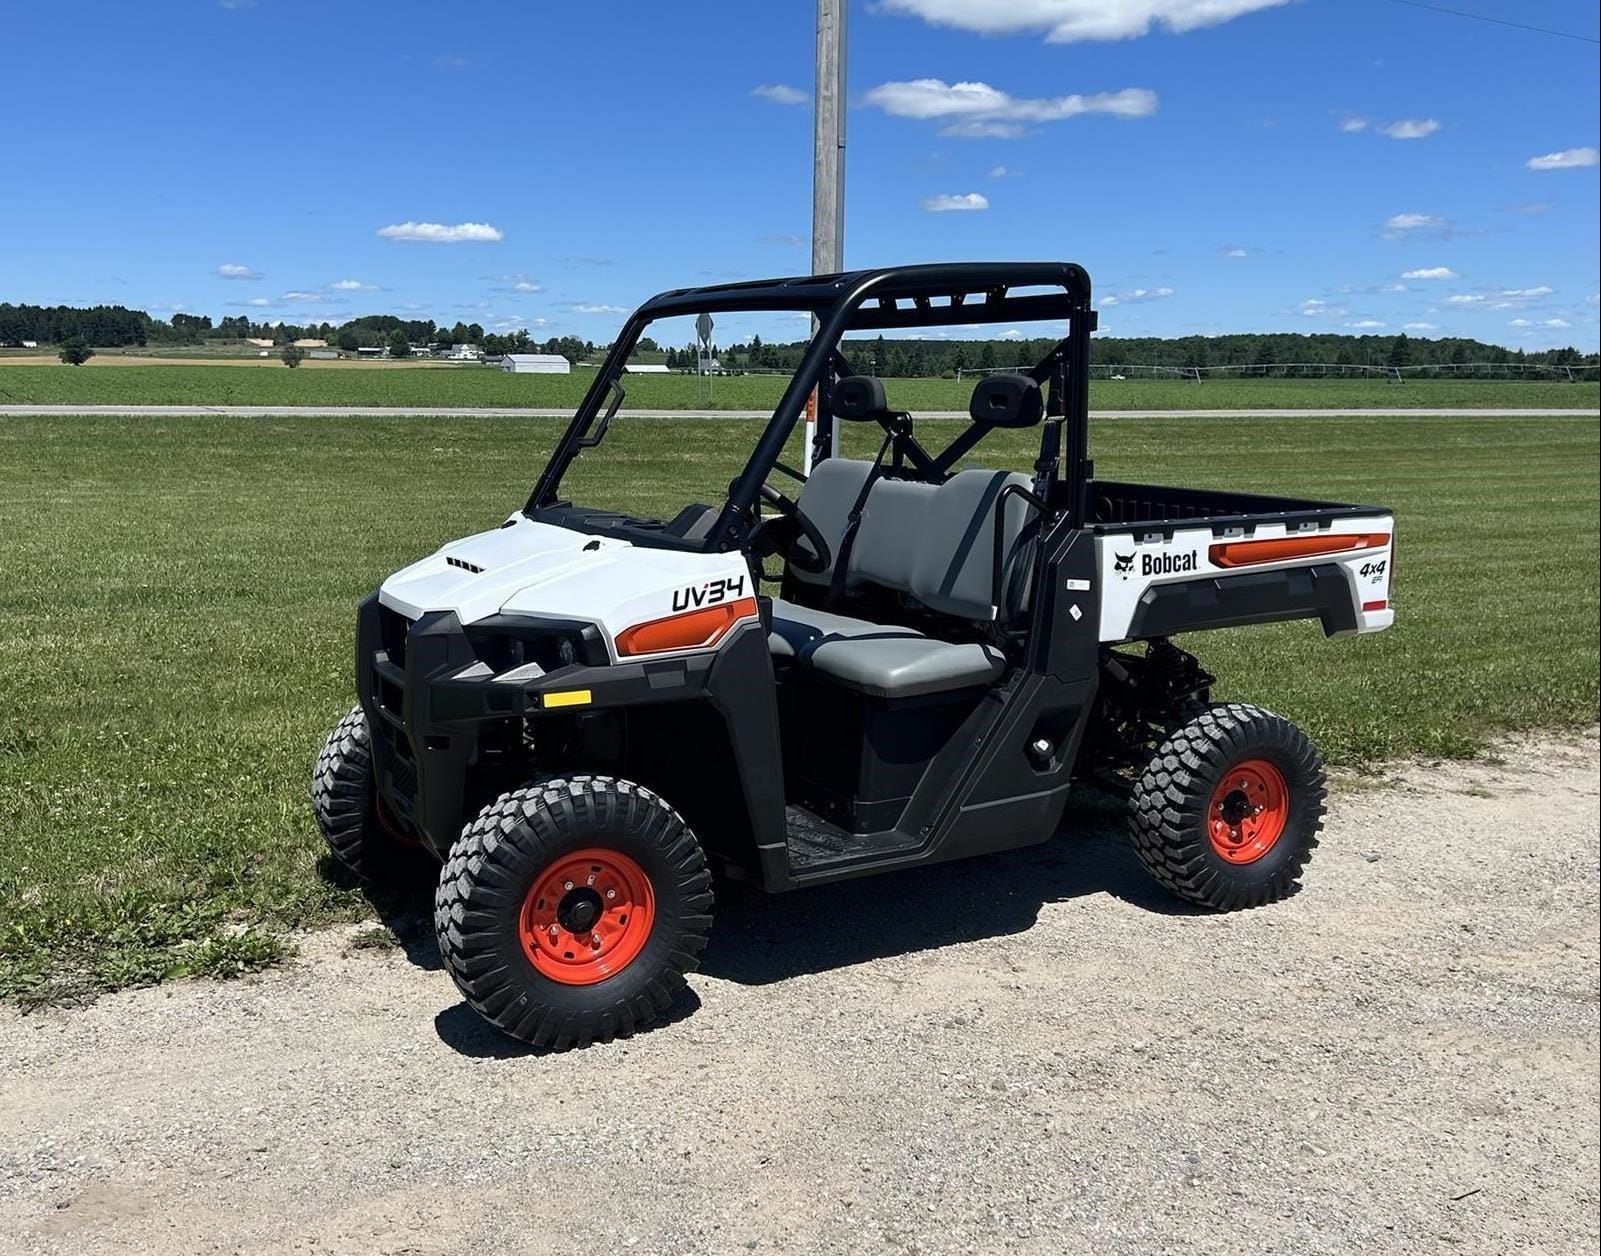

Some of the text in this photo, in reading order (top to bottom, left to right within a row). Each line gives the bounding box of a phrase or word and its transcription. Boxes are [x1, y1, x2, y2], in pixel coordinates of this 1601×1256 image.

[1142, 549, 1197, 576] Bobcat
[1360, 560, 1386, 578] 4x4
[672, 575, 744, 612] UV34
